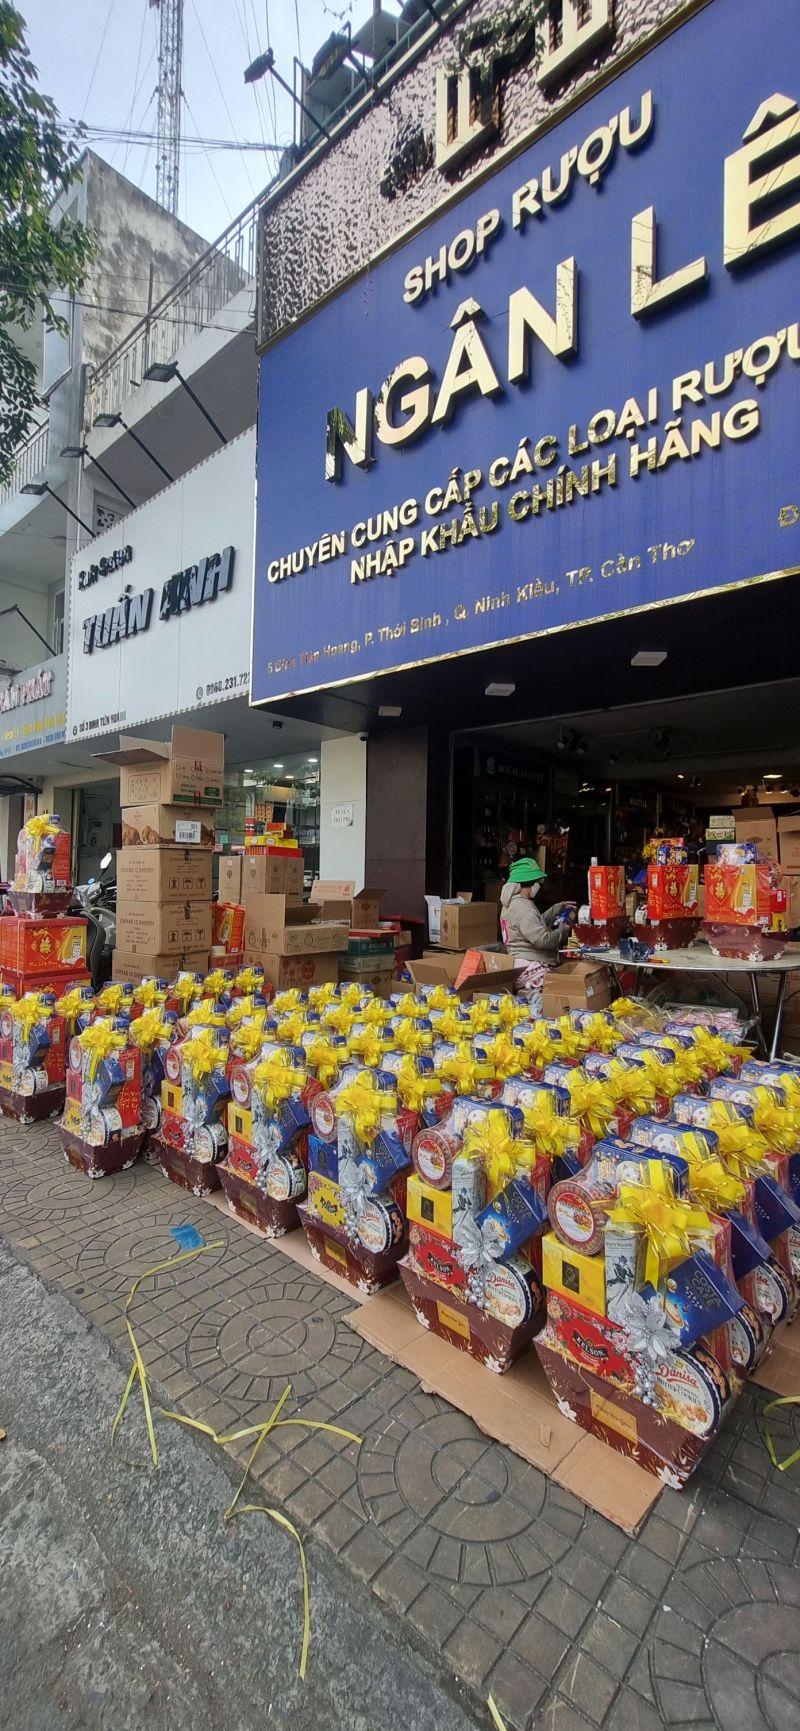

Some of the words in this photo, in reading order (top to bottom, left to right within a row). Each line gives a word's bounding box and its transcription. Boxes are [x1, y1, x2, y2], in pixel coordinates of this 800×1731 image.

[325, 256, 578, 483] NGÂN
[630, 92, 800, 320] LÊ
[403, 209, 500, 303] SHOP
[512, 90, 653, 230] RƯỢU
[267, 529, 346, 583] CHUYÊN
[350, 498, 418, 548] CUNG
[424, 467, 482, 515] CẤP
[488, 434, 558, 488] CÁC
[568, 388, 658, 456] LOẠI
[350, 536, 415, 584] NHẬP
[420, 502, 498, 557] KHẨU
[508, 455, 616, 522] CHÍNH
[629, 398, 760, 478] HÃNG
[364, 632, 374, 646] P.
[474, 592, 511, 615] Ninh
[647, 538, 696, 564] Thơ
[487, 1272, 516, 1290] Danisa
[655, 1362, 699, 1388] Danisa
